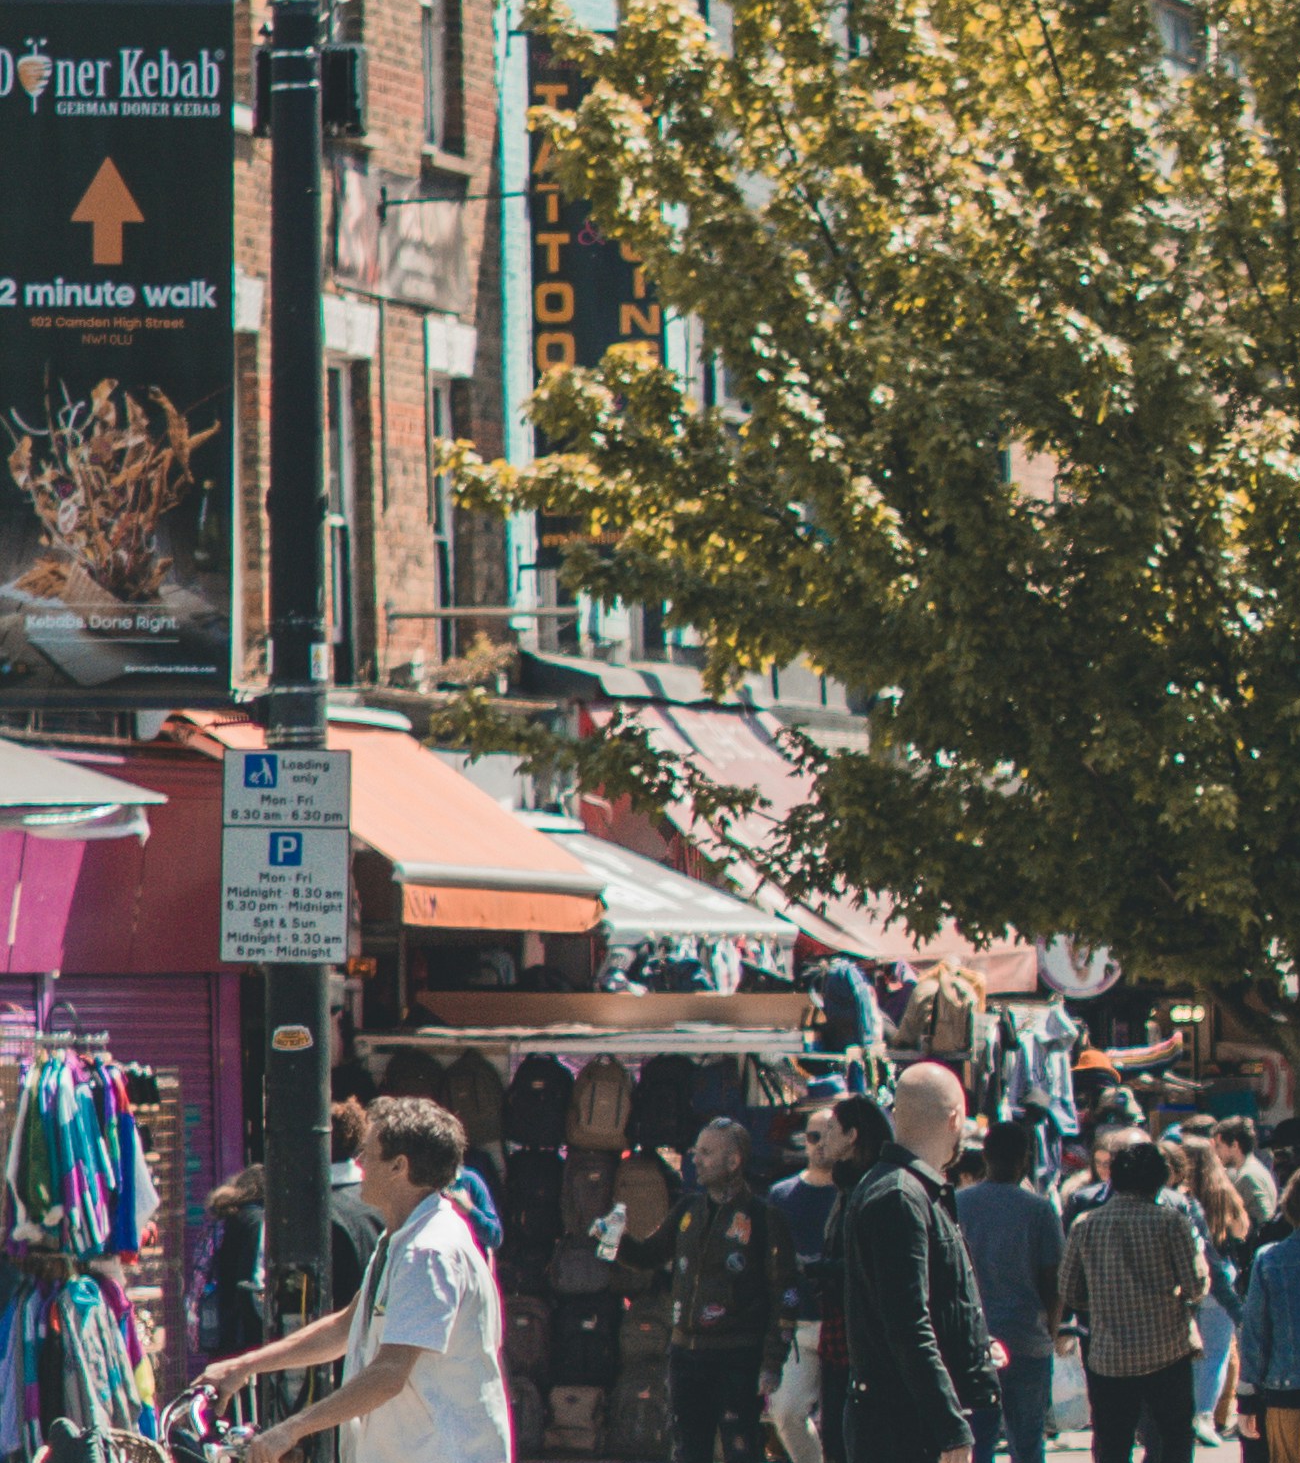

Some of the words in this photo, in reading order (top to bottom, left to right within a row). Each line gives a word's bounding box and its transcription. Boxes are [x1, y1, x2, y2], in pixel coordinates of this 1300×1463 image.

[55, 102, 118, 116] GERMAN
[173, 103, 221, 116] KEBAB
[0, 278, 17, 306] 2
[25, 277, 136, 307] minute
[143, 279, 217, 308] walk
[55, 317, 110, 328] Camden
[113, 317, 142, 331] High
[145, 317, 185, 329] Street
[89, 615, 134, 629] Done
[136, 615, 180, 632] Right.
[281, 758, 330, 772] Loading
[292, 774, 318, 785] only
[260, 795, 287, 805] Mon
[297, 795, 314, 805] Fri
[230, 811, 261, 820] 8.30
[290, 811, 321, 821] 6.30
[323, 813, 343, 823] pm
[277, 836, 298, 863] P
[259, 873, 286, 883] Mon
[296, 873, 312, 883] Fri
[227, 887, 282, 899] Midnight
[292, 888, 322, 898] 8.30
[227, 901, 256, 911] 6.30
[258, 903, 278, 913] pm
[288, 901, 343, 913] Midnight
[253, 917, 275, 929] Sat
[279, 918, 287, 928] &
[293, 917, 316, 928] Sun
[227, 932, 282, 944] Midnight
[323, 936, 342, 944] am
[237, 946, 244, 956] 6
[247, 948, 266, 958] pm
[276, 946, 332, 958] Midnight
